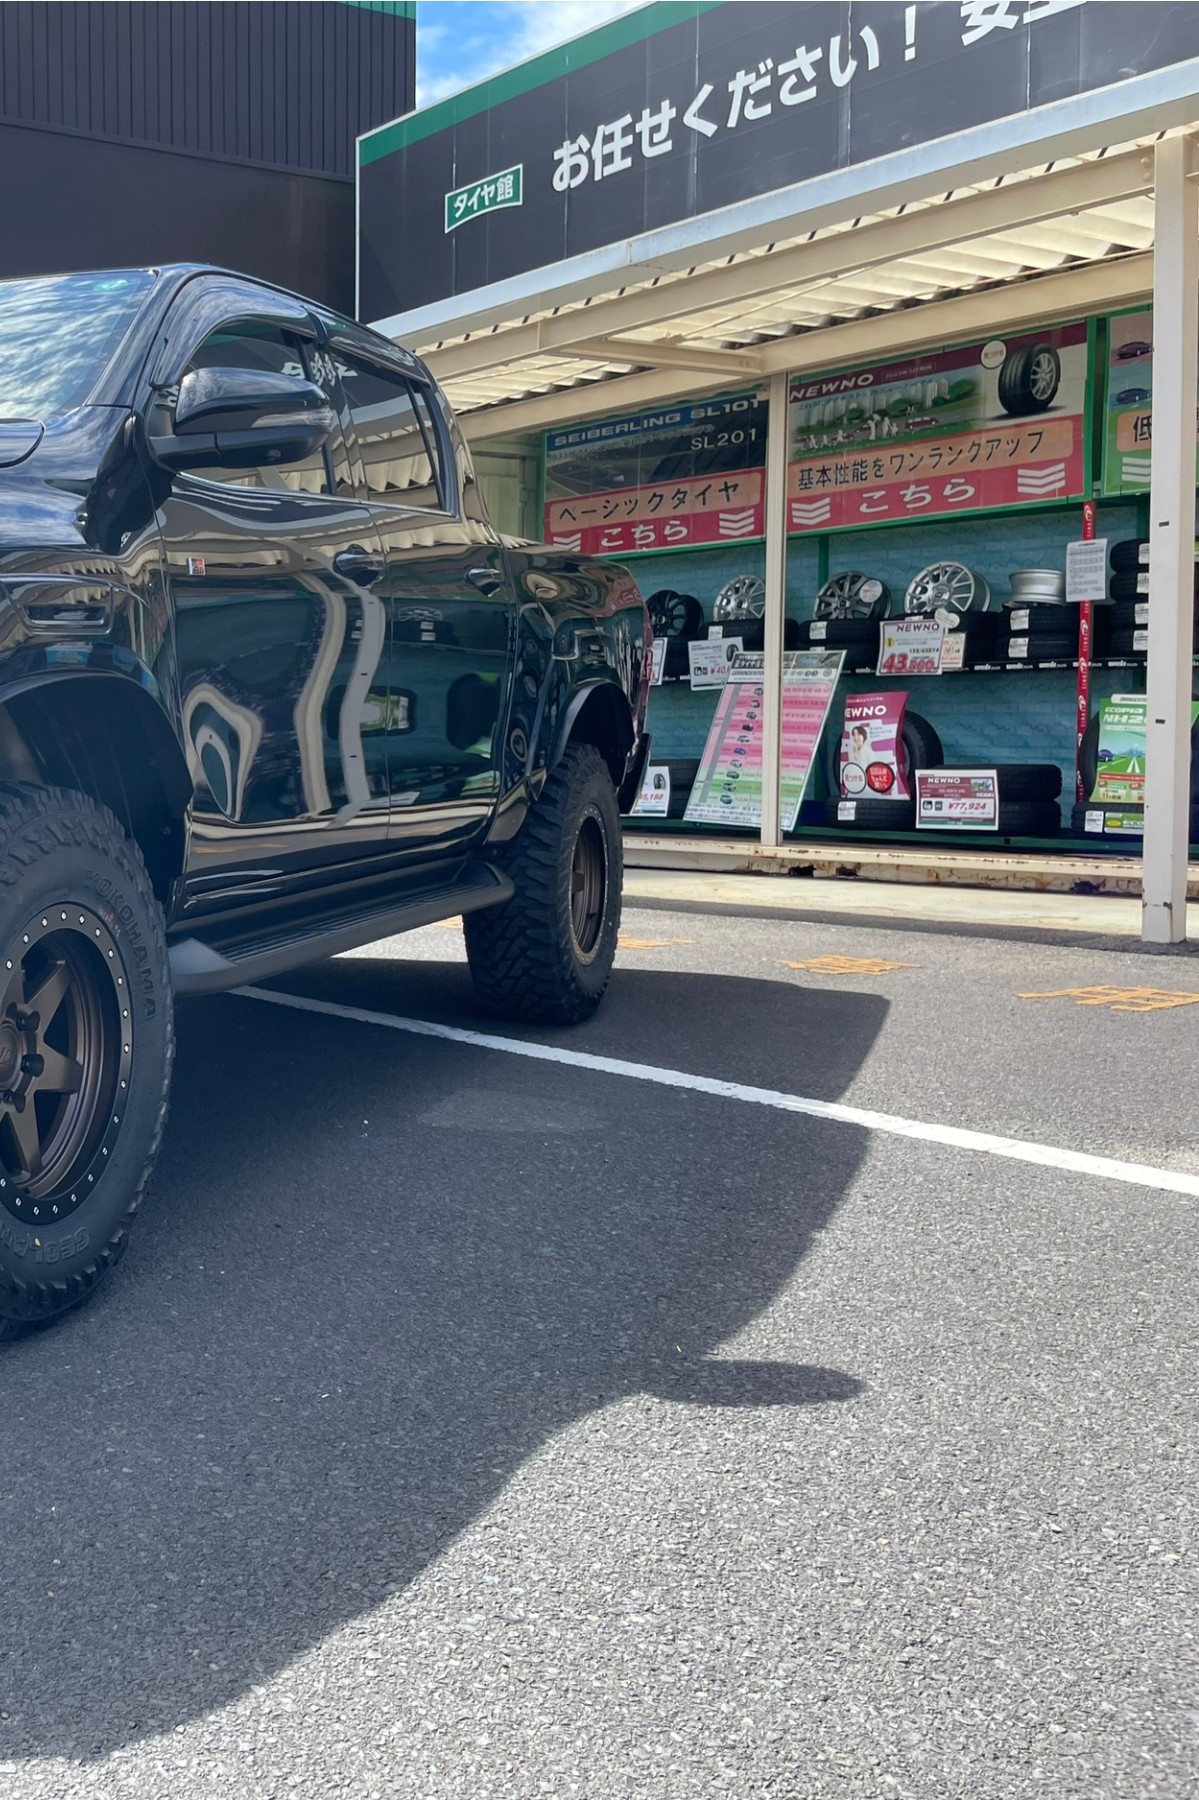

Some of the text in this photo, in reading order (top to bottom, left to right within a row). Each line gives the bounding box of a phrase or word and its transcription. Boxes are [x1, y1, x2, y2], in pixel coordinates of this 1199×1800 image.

[453, 174, 514, 218] タイヤ館
[790, 374, 874, 401] NEWNO
[555, 412, 681, 446] SEIBERLING
[690, 400, 760, 420] SL101
[690, 428, 757, 450] SL201
[798, 431, 1045, 490] 基本性能をワンランクアップ
[559, 481, 740, 521] ベーシックタイヤ
[858, 478, 976, 513] こちら
[601, 519, 688, 547] こちら
[896, 622, 941, 633] NEWNO
[845, 705, 887, 718] EWNO
[1103, 714, 1147, 724] NH2
[84, 869, 157, 1020] YOKOHAMA
